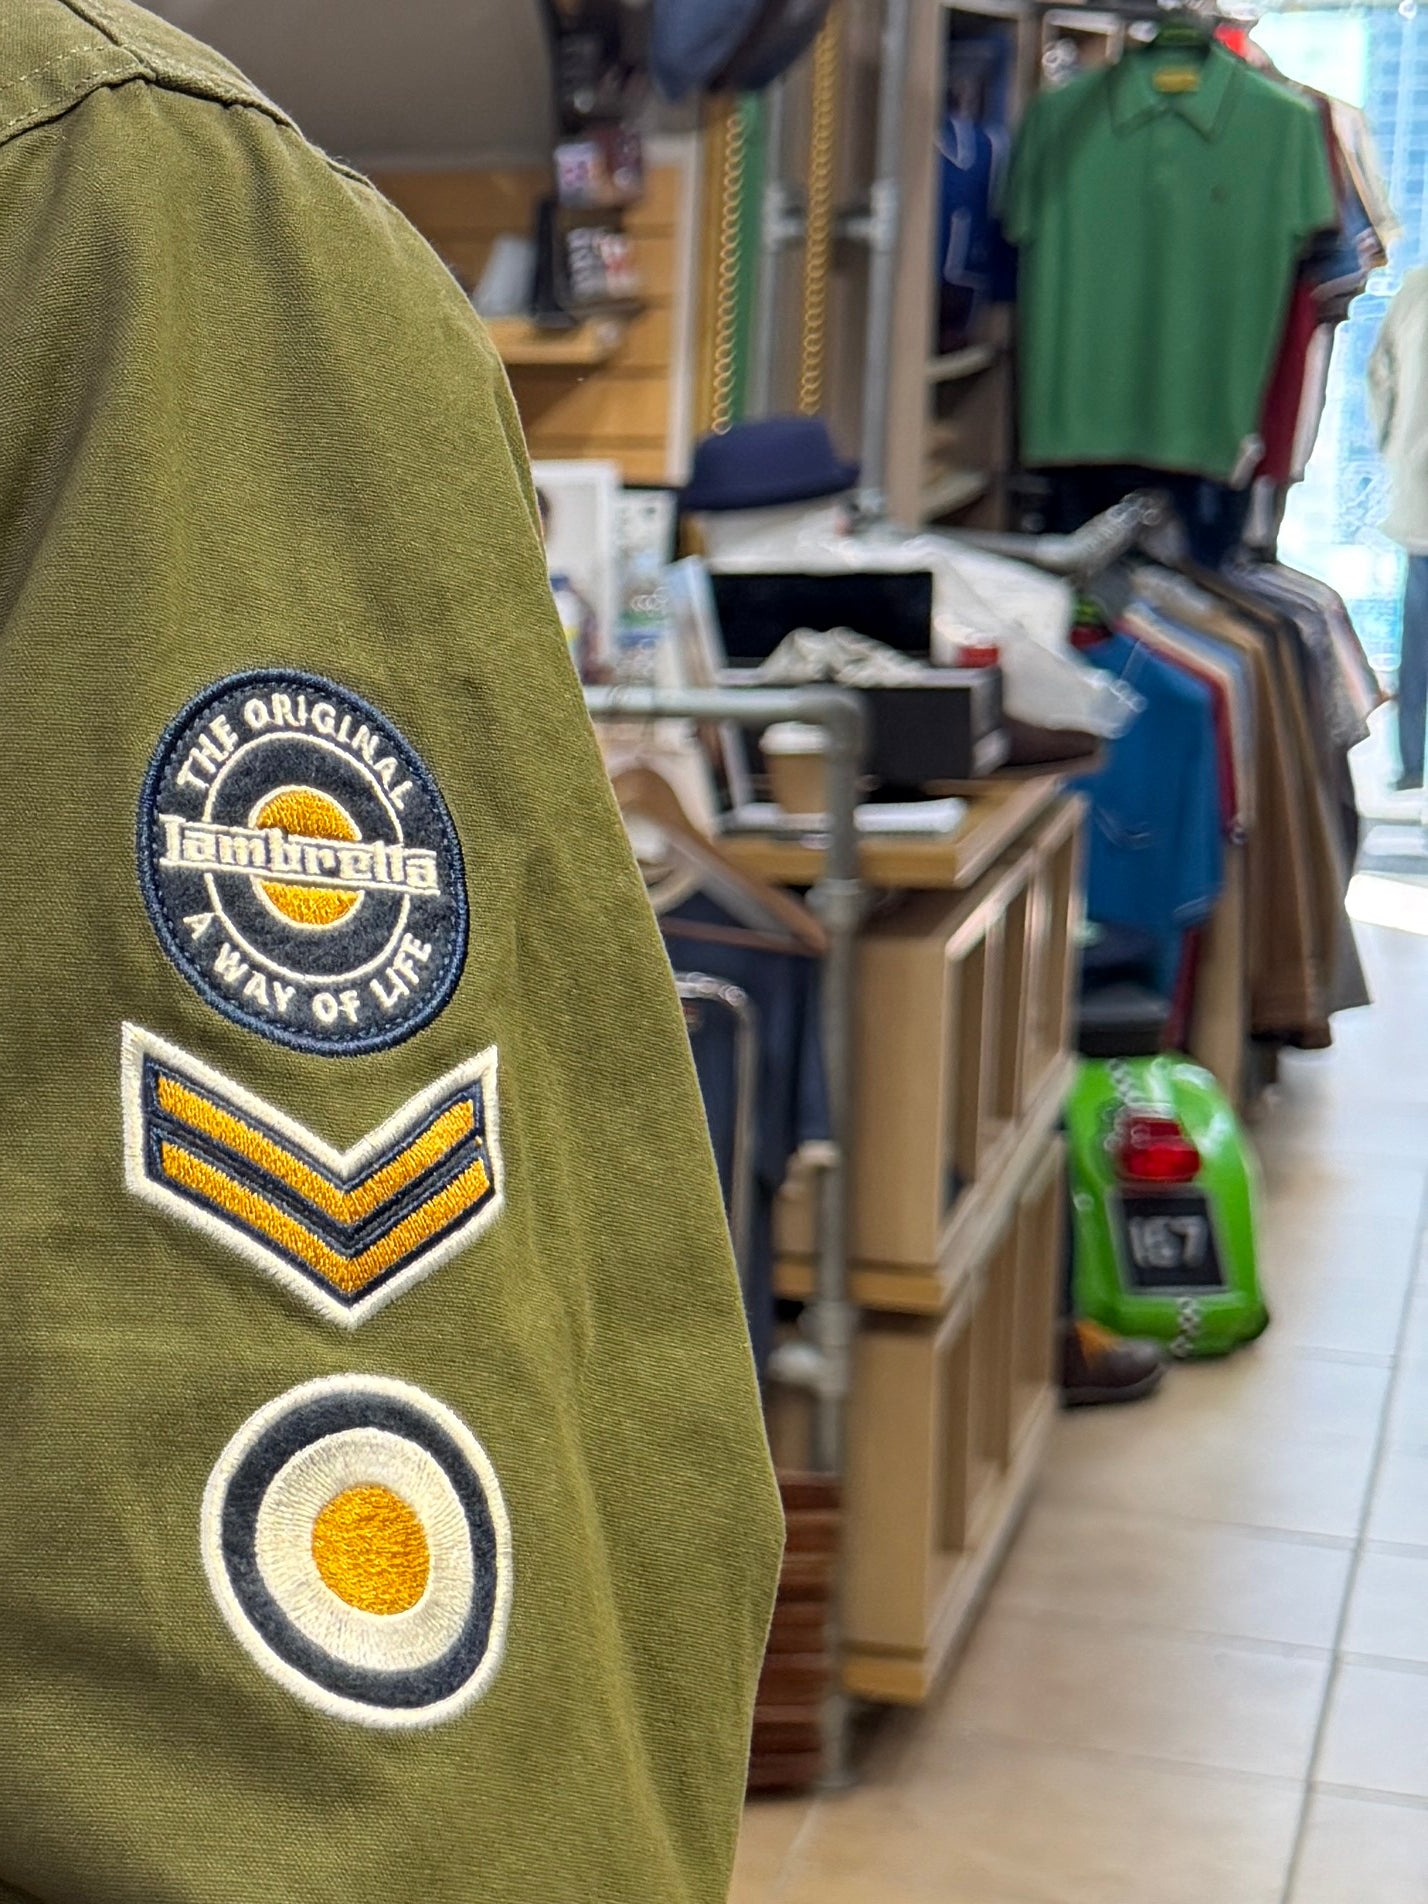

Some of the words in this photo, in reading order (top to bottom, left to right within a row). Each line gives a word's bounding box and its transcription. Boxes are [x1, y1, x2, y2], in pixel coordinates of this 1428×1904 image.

[176, 714, 239, 792] THE
[244, 693, 414, 811] ORIGINAL
[157, 813, 441, 897] Lambretta
[183, 912, 222, 942] A
[214, 942, 296, 1014] WAY
[311, 991, 361, 1025] OF
[369, 932, 433, 1008] LIFE
